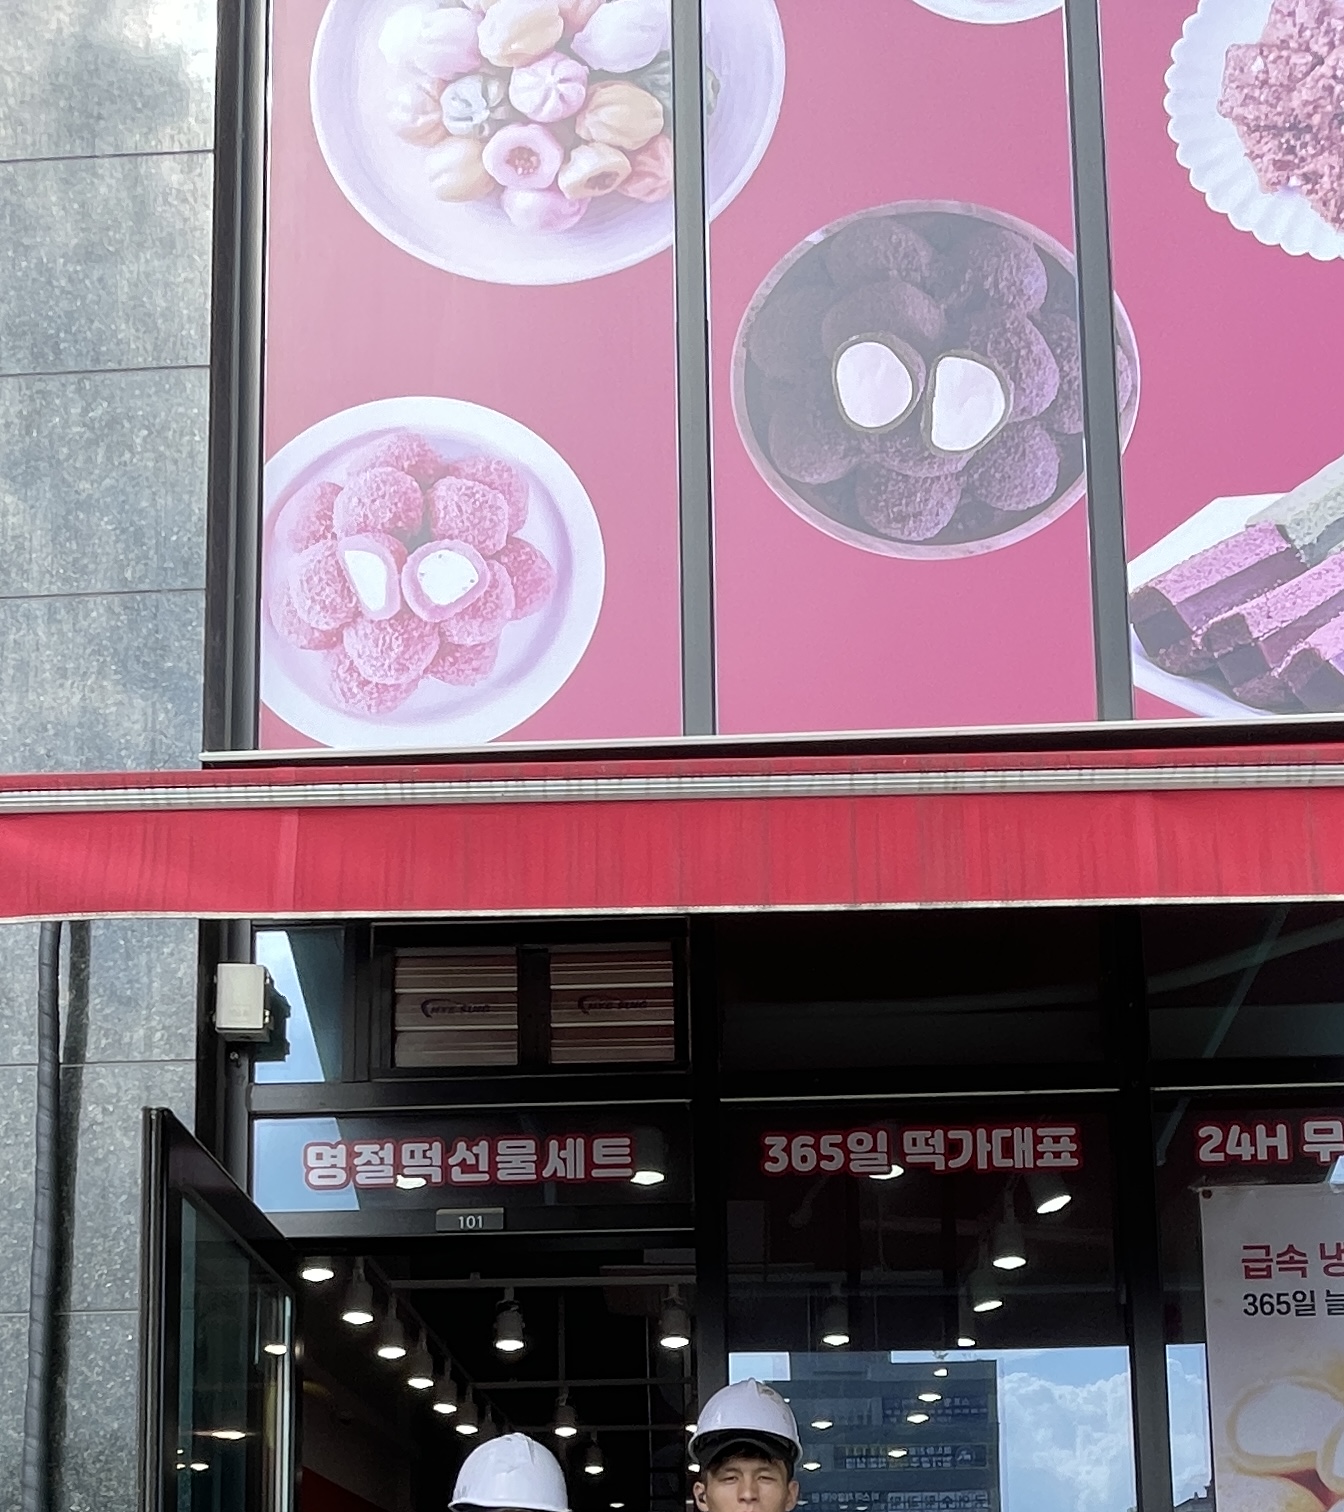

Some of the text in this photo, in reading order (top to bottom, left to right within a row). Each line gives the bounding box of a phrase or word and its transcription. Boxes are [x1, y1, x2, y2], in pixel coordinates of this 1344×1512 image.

[305, 1136, 633, 1187] 명절떡선물세트
[763, 1126, 1079, 1173] 365일 떡가대표
[1197, 1122, 1290, 1162] 24H
[457, 1214, 484, 1230] 101
[1240, 1242, 1310, 1281] 급속
[1242, 1289, 1317, 1318] 365일
